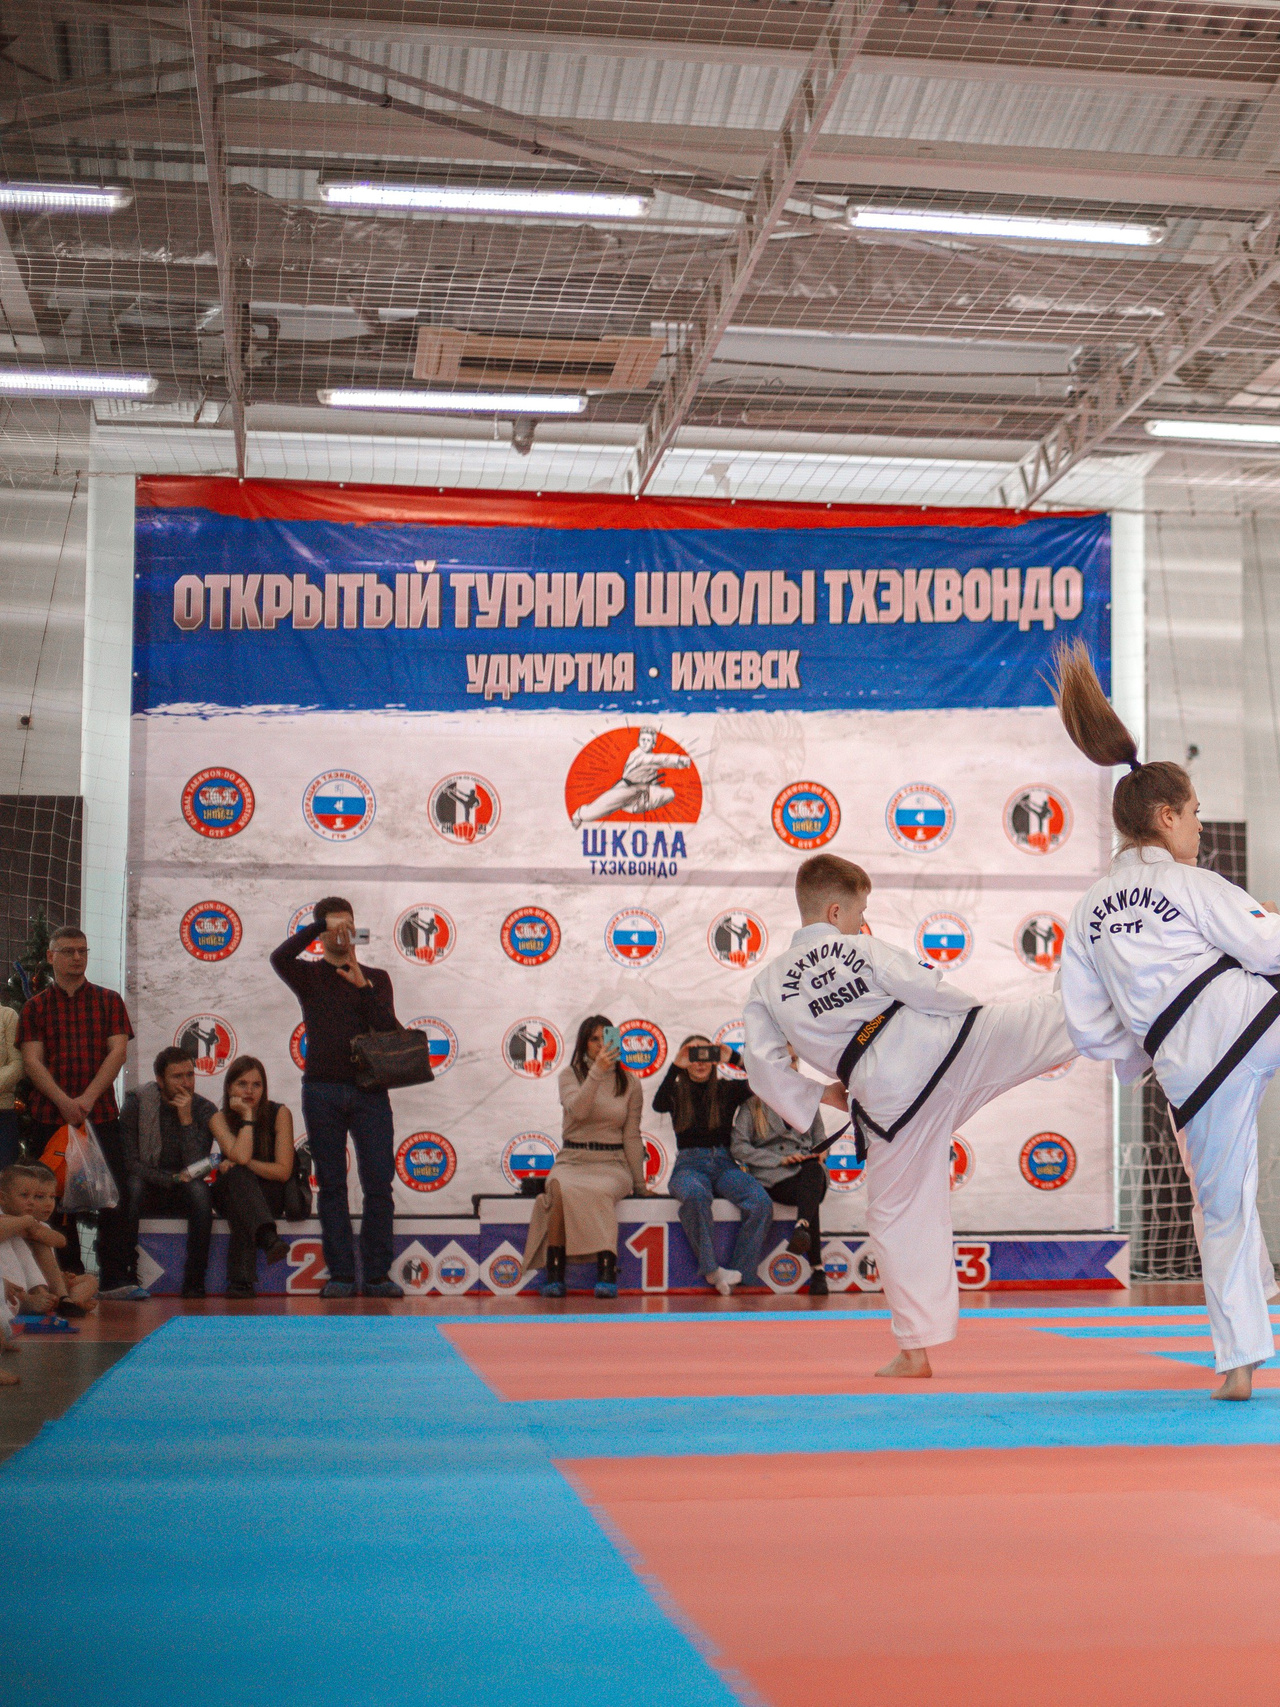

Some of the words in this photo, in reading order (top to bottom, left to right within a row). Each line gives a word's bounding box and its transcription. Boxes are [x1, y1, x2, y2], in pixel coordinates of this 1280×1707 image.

[173, 560, 440, 630] ОТКРЫТЫЙ
[449, 571, 626, 629] ТУРНИР
[634, 569, 816, 627] ШКОЛЫ
[823, 565, 1083, 632] ТХЭКВОНДО
[466, 651, 635, 701] УДМУРТИЯ
[671, 649, 800, 691] ИЖЕВСК
[582, 829, 687, 858] ШКОЛА
[590, 860, 678, 878] ТХЭКВОНДО
[1090, 887, 1181, 944] TAEKWON-DO
[1109, 919, 1144, 934] GTF
[781, 942, 867, 1002] TAEKWON-DO
[811, 967, 837, 990] GTF
[808, 977, 870, 1018] RUSSIA
[857, 1014, 886, 1046] RUSSIA
[286, 1238, 331, 1294] 2
[625, 1222, 669, 1292] 1
[954, 1243, 990, 1289] 3
